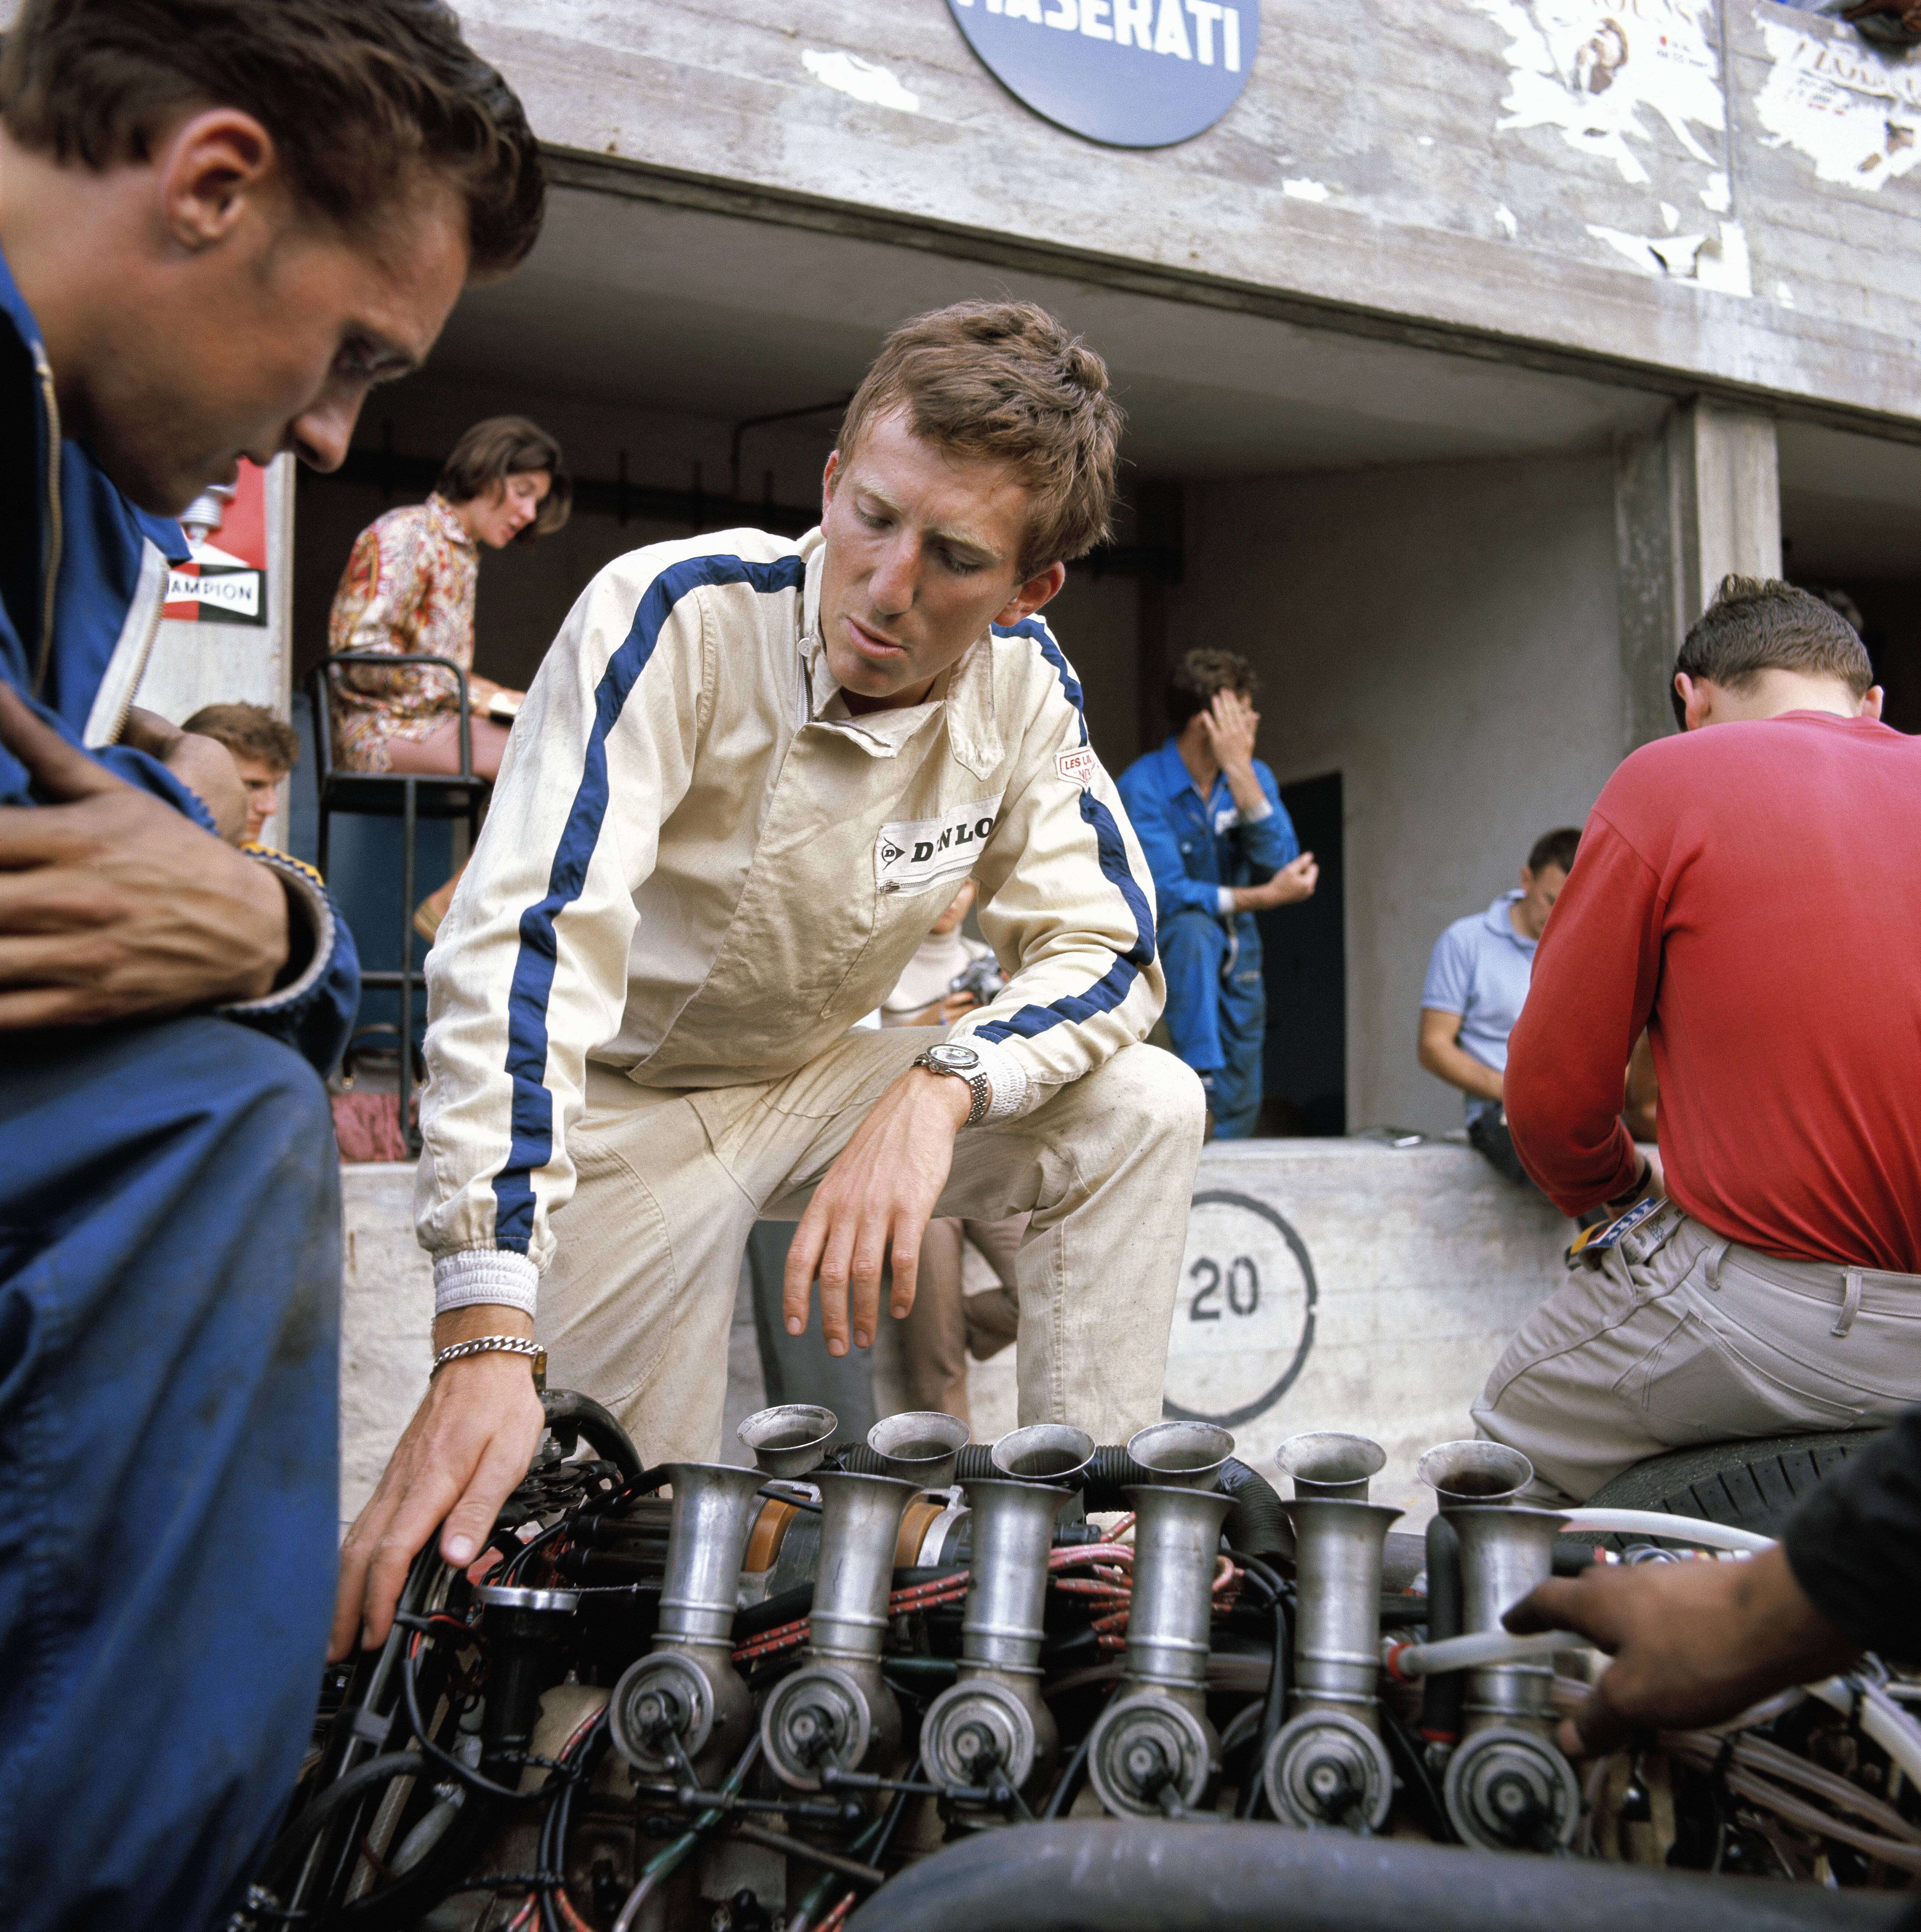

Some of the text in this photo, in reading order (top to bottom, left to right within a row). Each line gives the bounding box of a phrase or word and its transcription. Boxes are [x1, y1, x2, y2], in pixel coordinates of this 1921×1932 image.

[957, 0, 1241, 72] SERATI
[1065, 757, 1081, 770] LES
[911, 817, 994, 863] DNLO
[1189, 1254, 1259, 1320] 20
